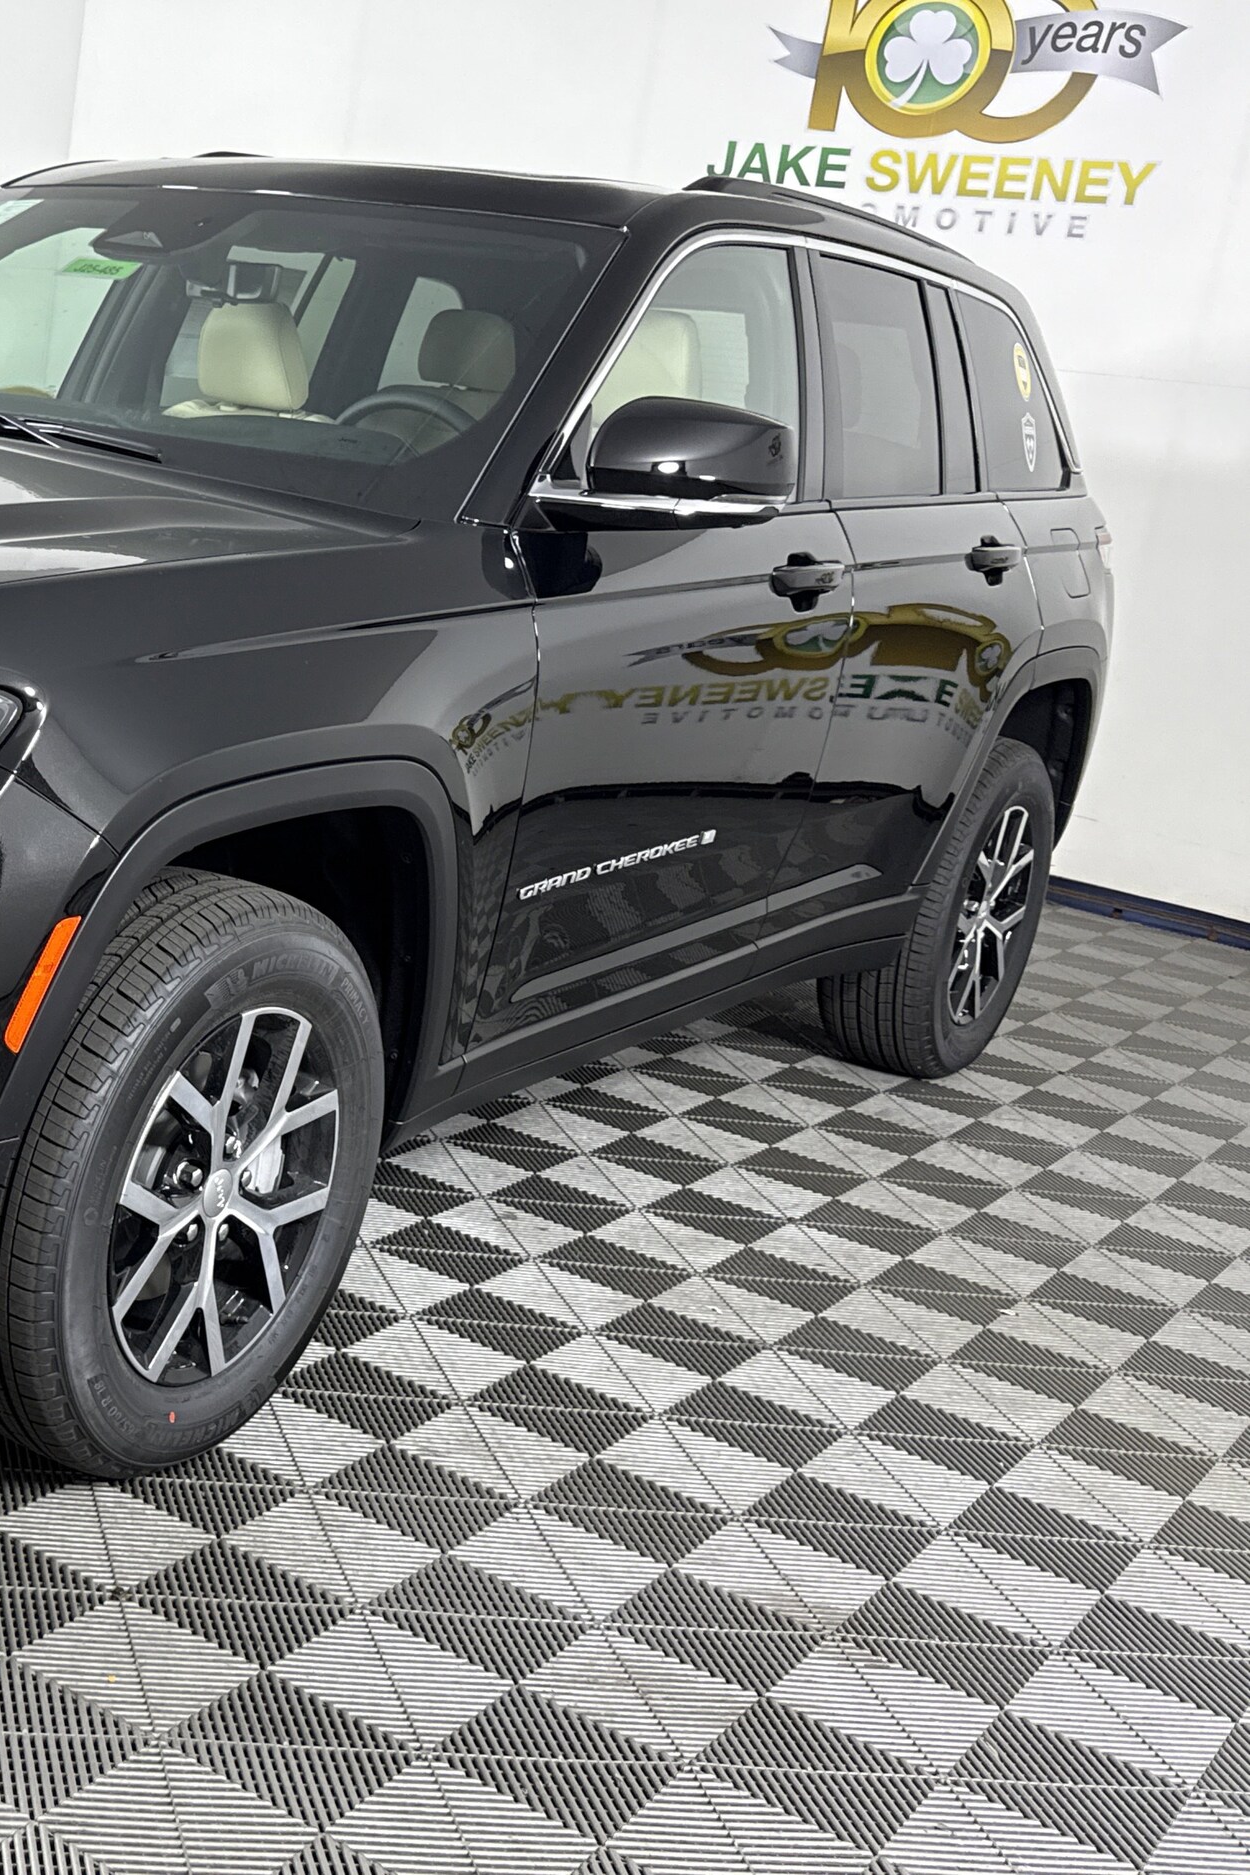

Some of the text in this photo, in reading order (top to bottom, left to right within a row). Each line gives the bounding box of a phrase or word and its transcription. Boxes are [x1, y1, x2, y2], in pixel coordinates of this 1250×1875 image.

[1021, 19, 1147, 67] years
[707, 140, 1157, 206] JAKE SWEENEY
[519, 834, 700, 900] GRAND CHEROKEE
[251, 953, 340, 986] MICHELIN
[340, 976, 369, 1026] PRIMACY
